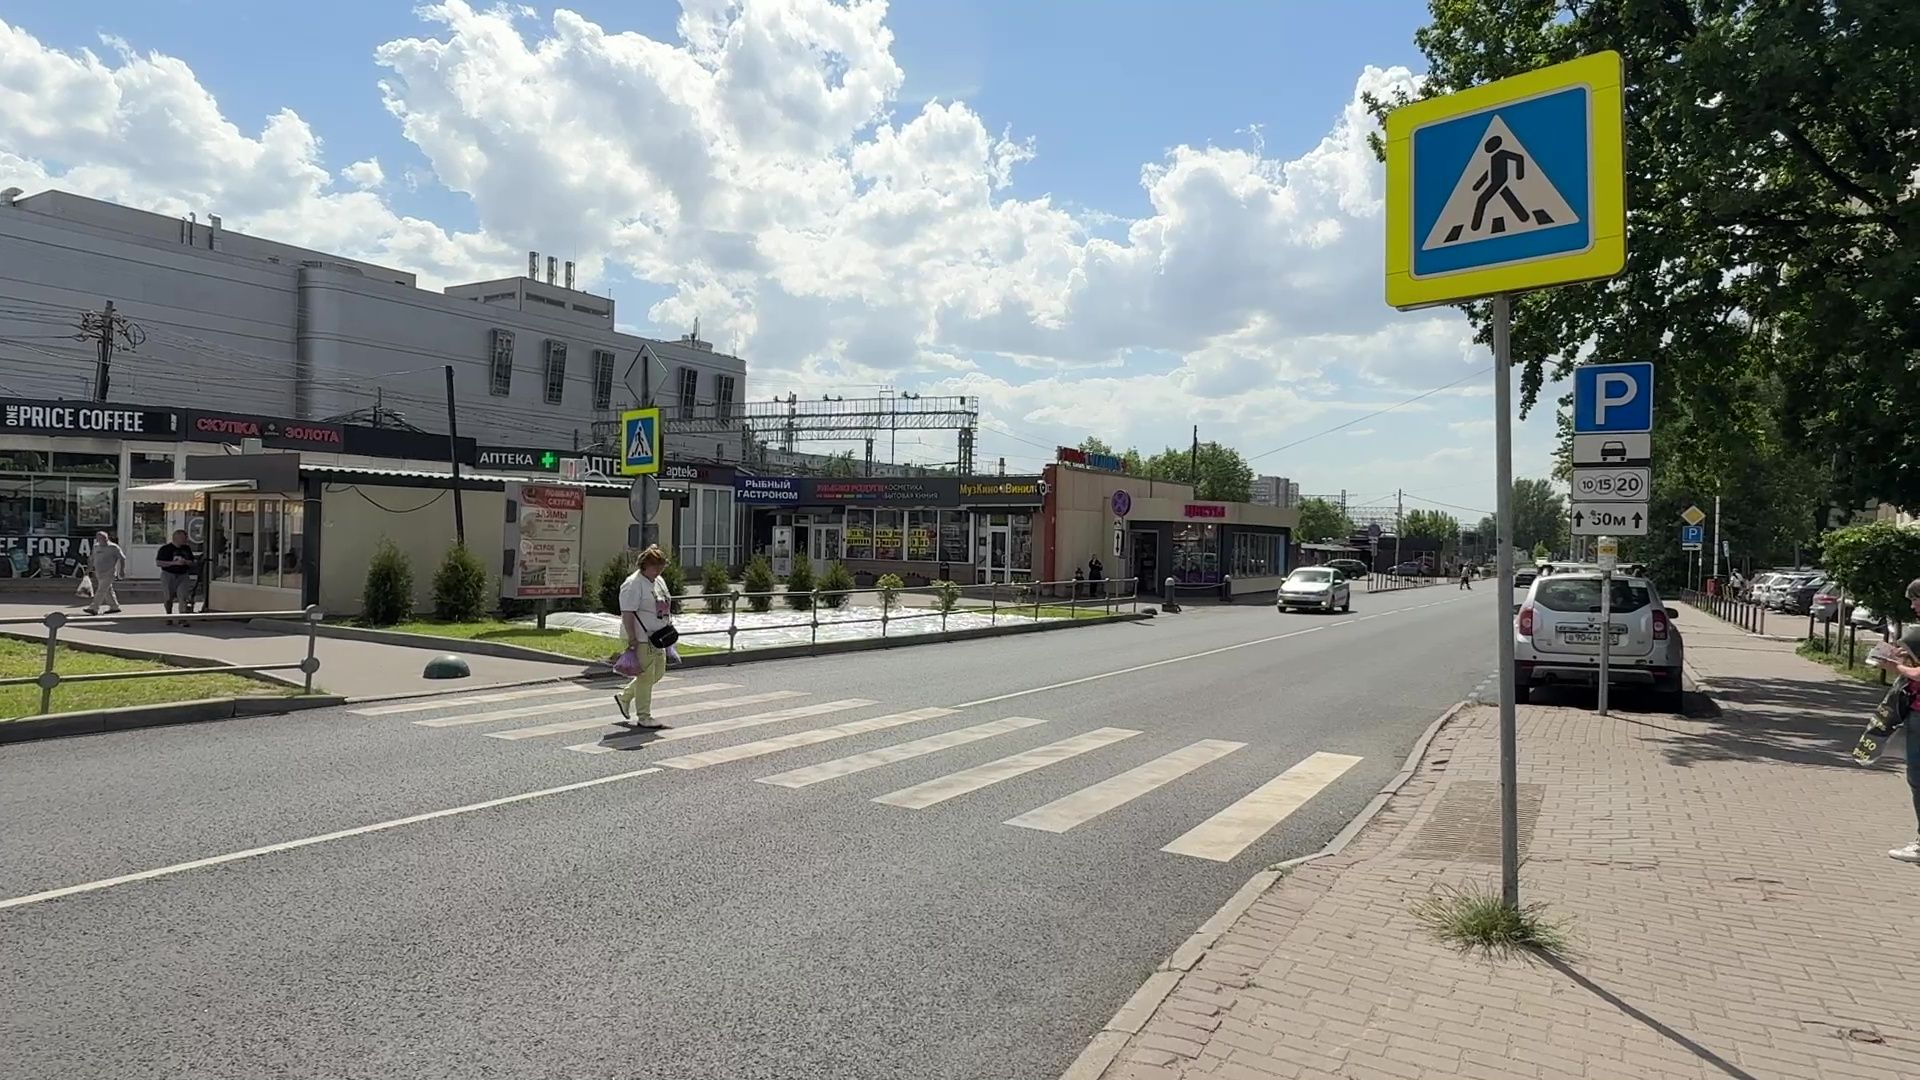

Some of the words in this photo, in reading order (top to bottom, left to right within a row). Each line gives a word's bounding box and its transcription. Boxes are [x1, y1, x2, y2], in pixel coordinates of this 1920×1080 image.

[1596, 372, 1638, 425] P
[6, 405, 18, 426] ONE
[19, 405, 75, 428] PRICE
[79, 408, 144, 432] COFFEE
[196, 418, 260, 435] СКУПКА
[284, 426, 340, 442] ЗОЛОТА
[479, 452, 534, 465] АПТЕКА
[582, 455, 622, 475] АПТЕ
[745, 479, 791, 489] РЫБНЫЙ
[1582, 480, 1594, 490] 10
[1598, 479, 1612, 491] 15
[1616, 477, 1640, 491] 20
[737, 489, 798, 500] ГАСТРОНОМ
[1688, 527, 1698, 541] P
